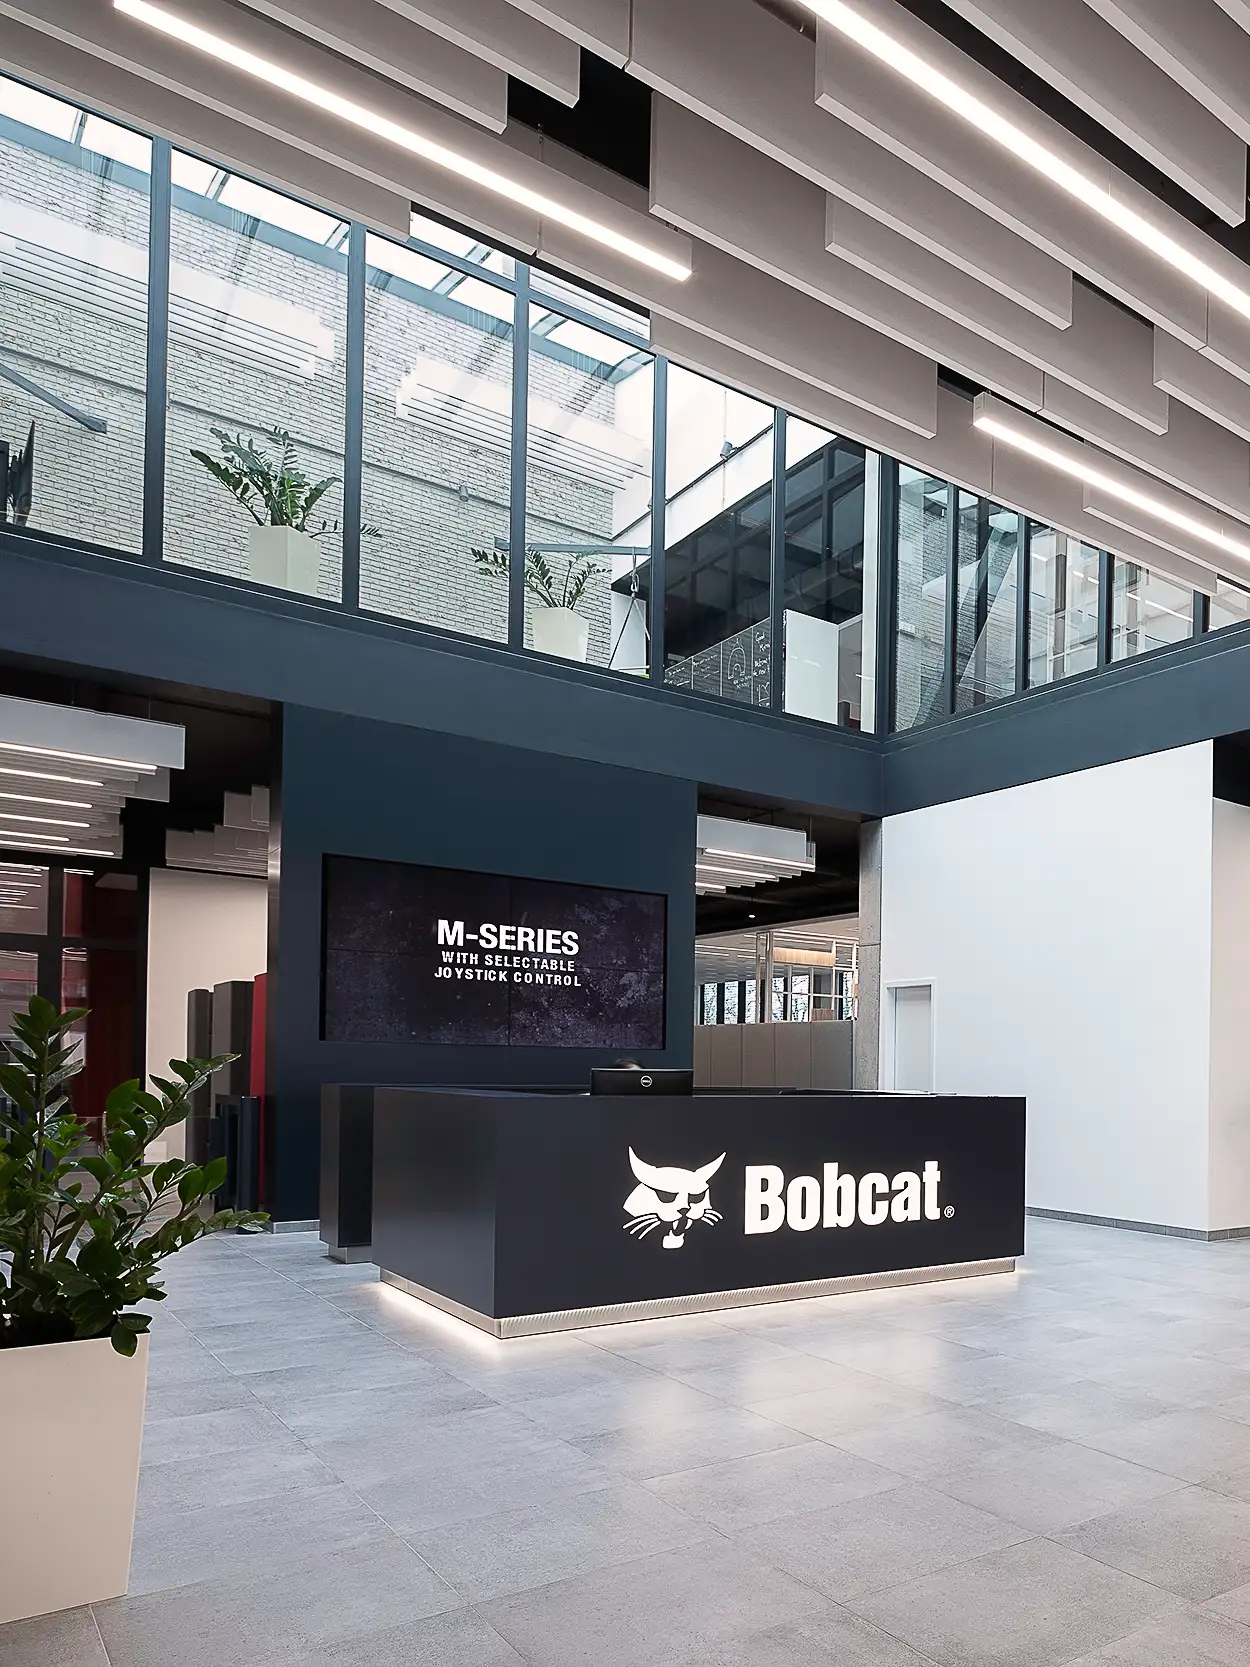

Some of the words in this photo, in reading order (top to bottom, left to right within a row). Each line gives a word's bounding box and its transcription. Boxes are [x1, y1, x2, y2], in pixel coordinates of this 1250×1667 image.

[437, 919, 580, 956] M-SERIES
[442, 951, 479, 965] WITH
[484, 954, 575, 972] SELECTABLE
[434, 966, 508, 982] JOYSTICK
[513, 972, 582, 987] CONTROL
